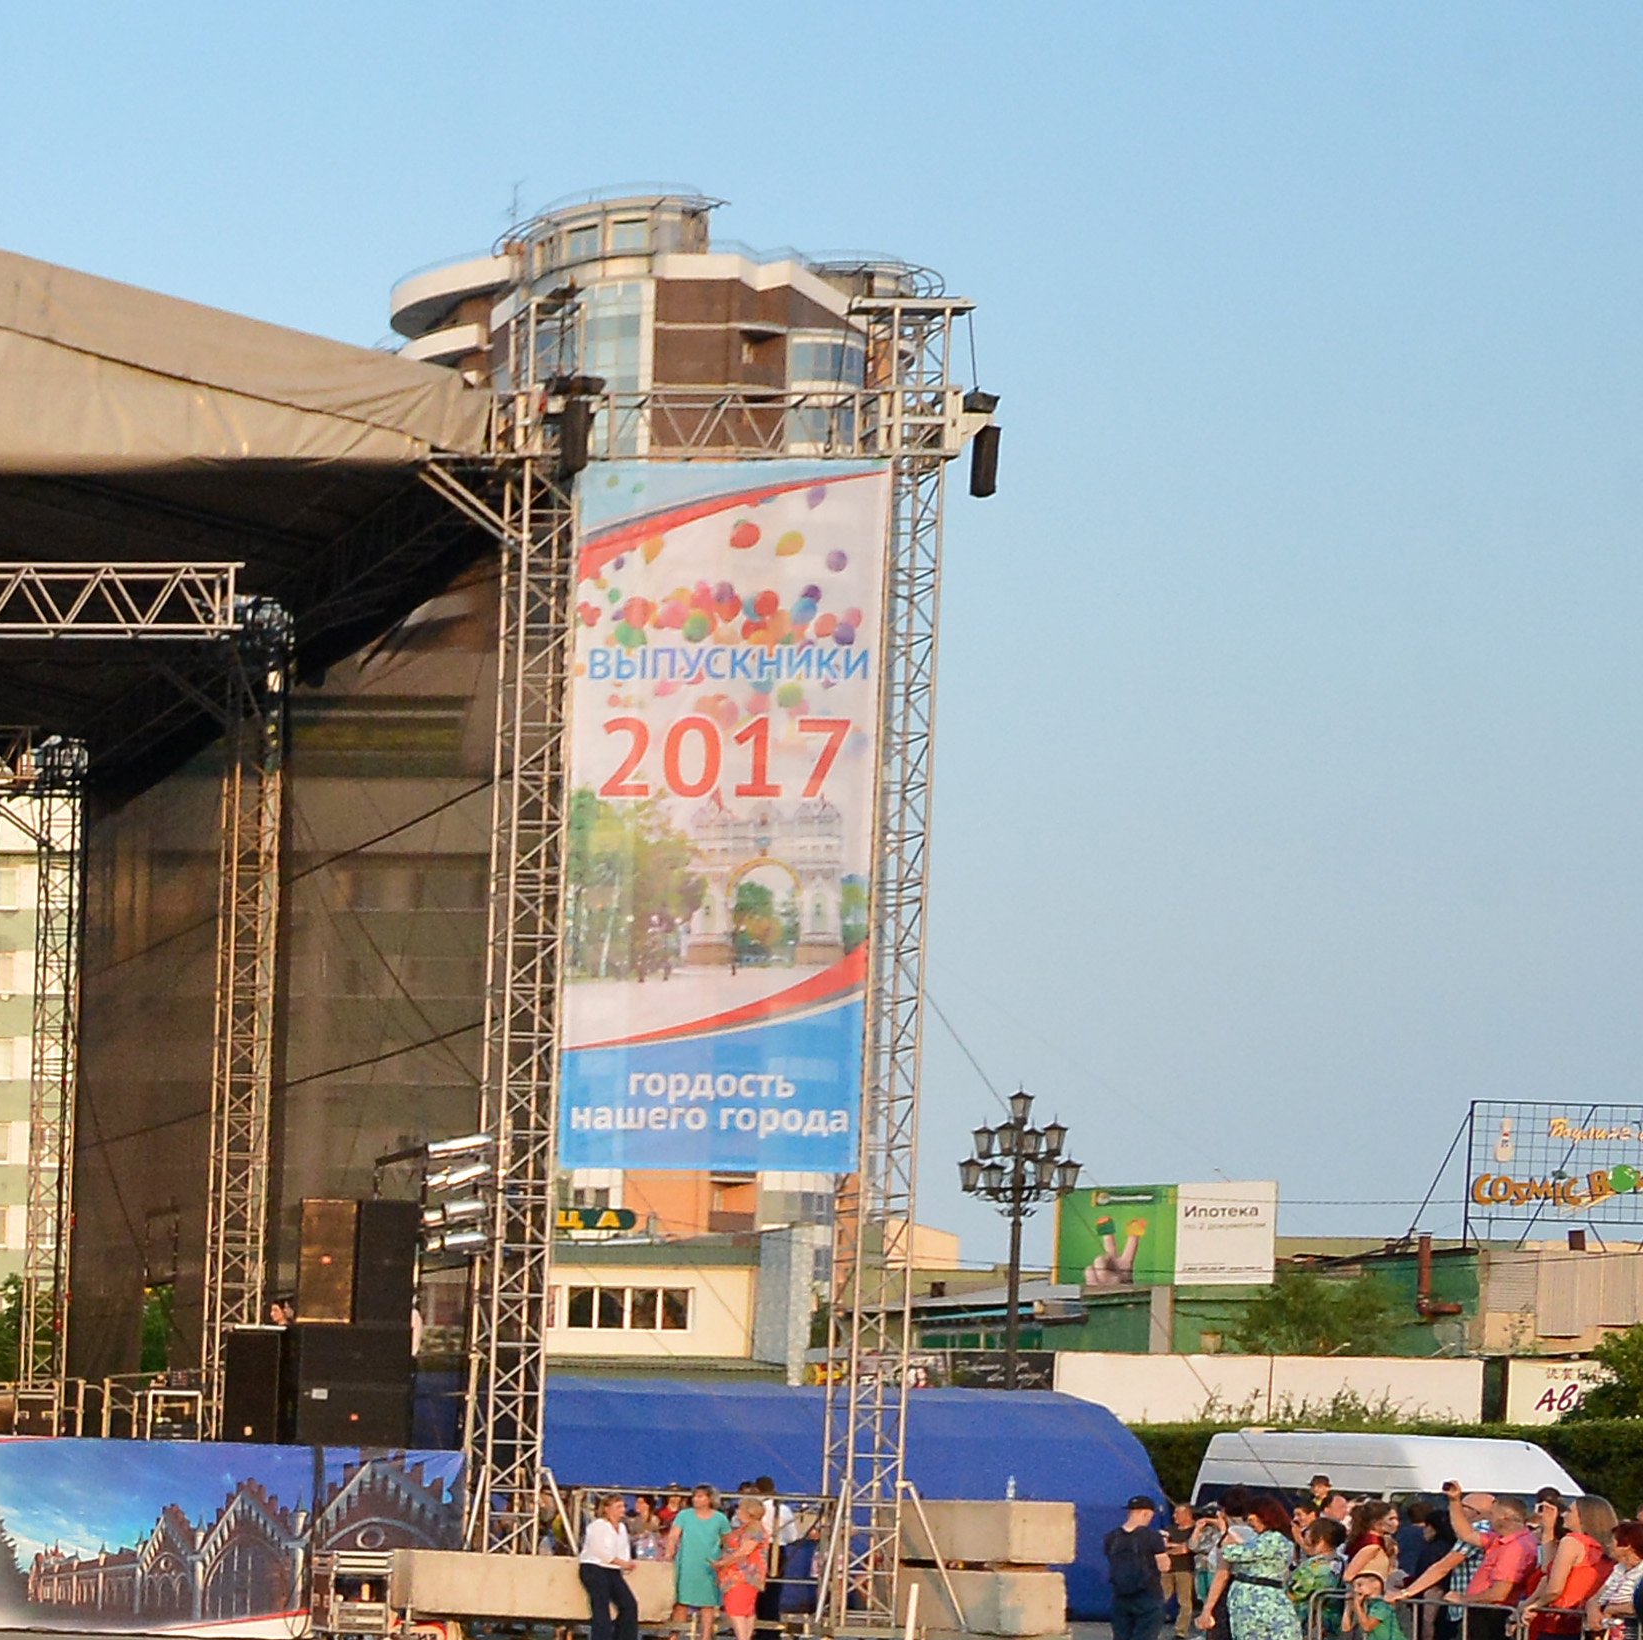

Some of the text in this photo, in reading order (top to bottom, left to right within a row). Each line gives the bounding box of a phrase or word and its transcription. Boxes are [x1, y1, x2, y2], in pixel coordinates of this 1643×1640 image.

[587, 647, 870, 680] ВЫПУСКНИКИ
[598, 715, 852, 798] 2017
[628, 1071, 796, 1104] гордость
[570, 1106, 850, 1139] нашего города
[1472, 1171, 1582, 1207] COSMIC
[1184, 1205, 1259, 1218] Ипотека
